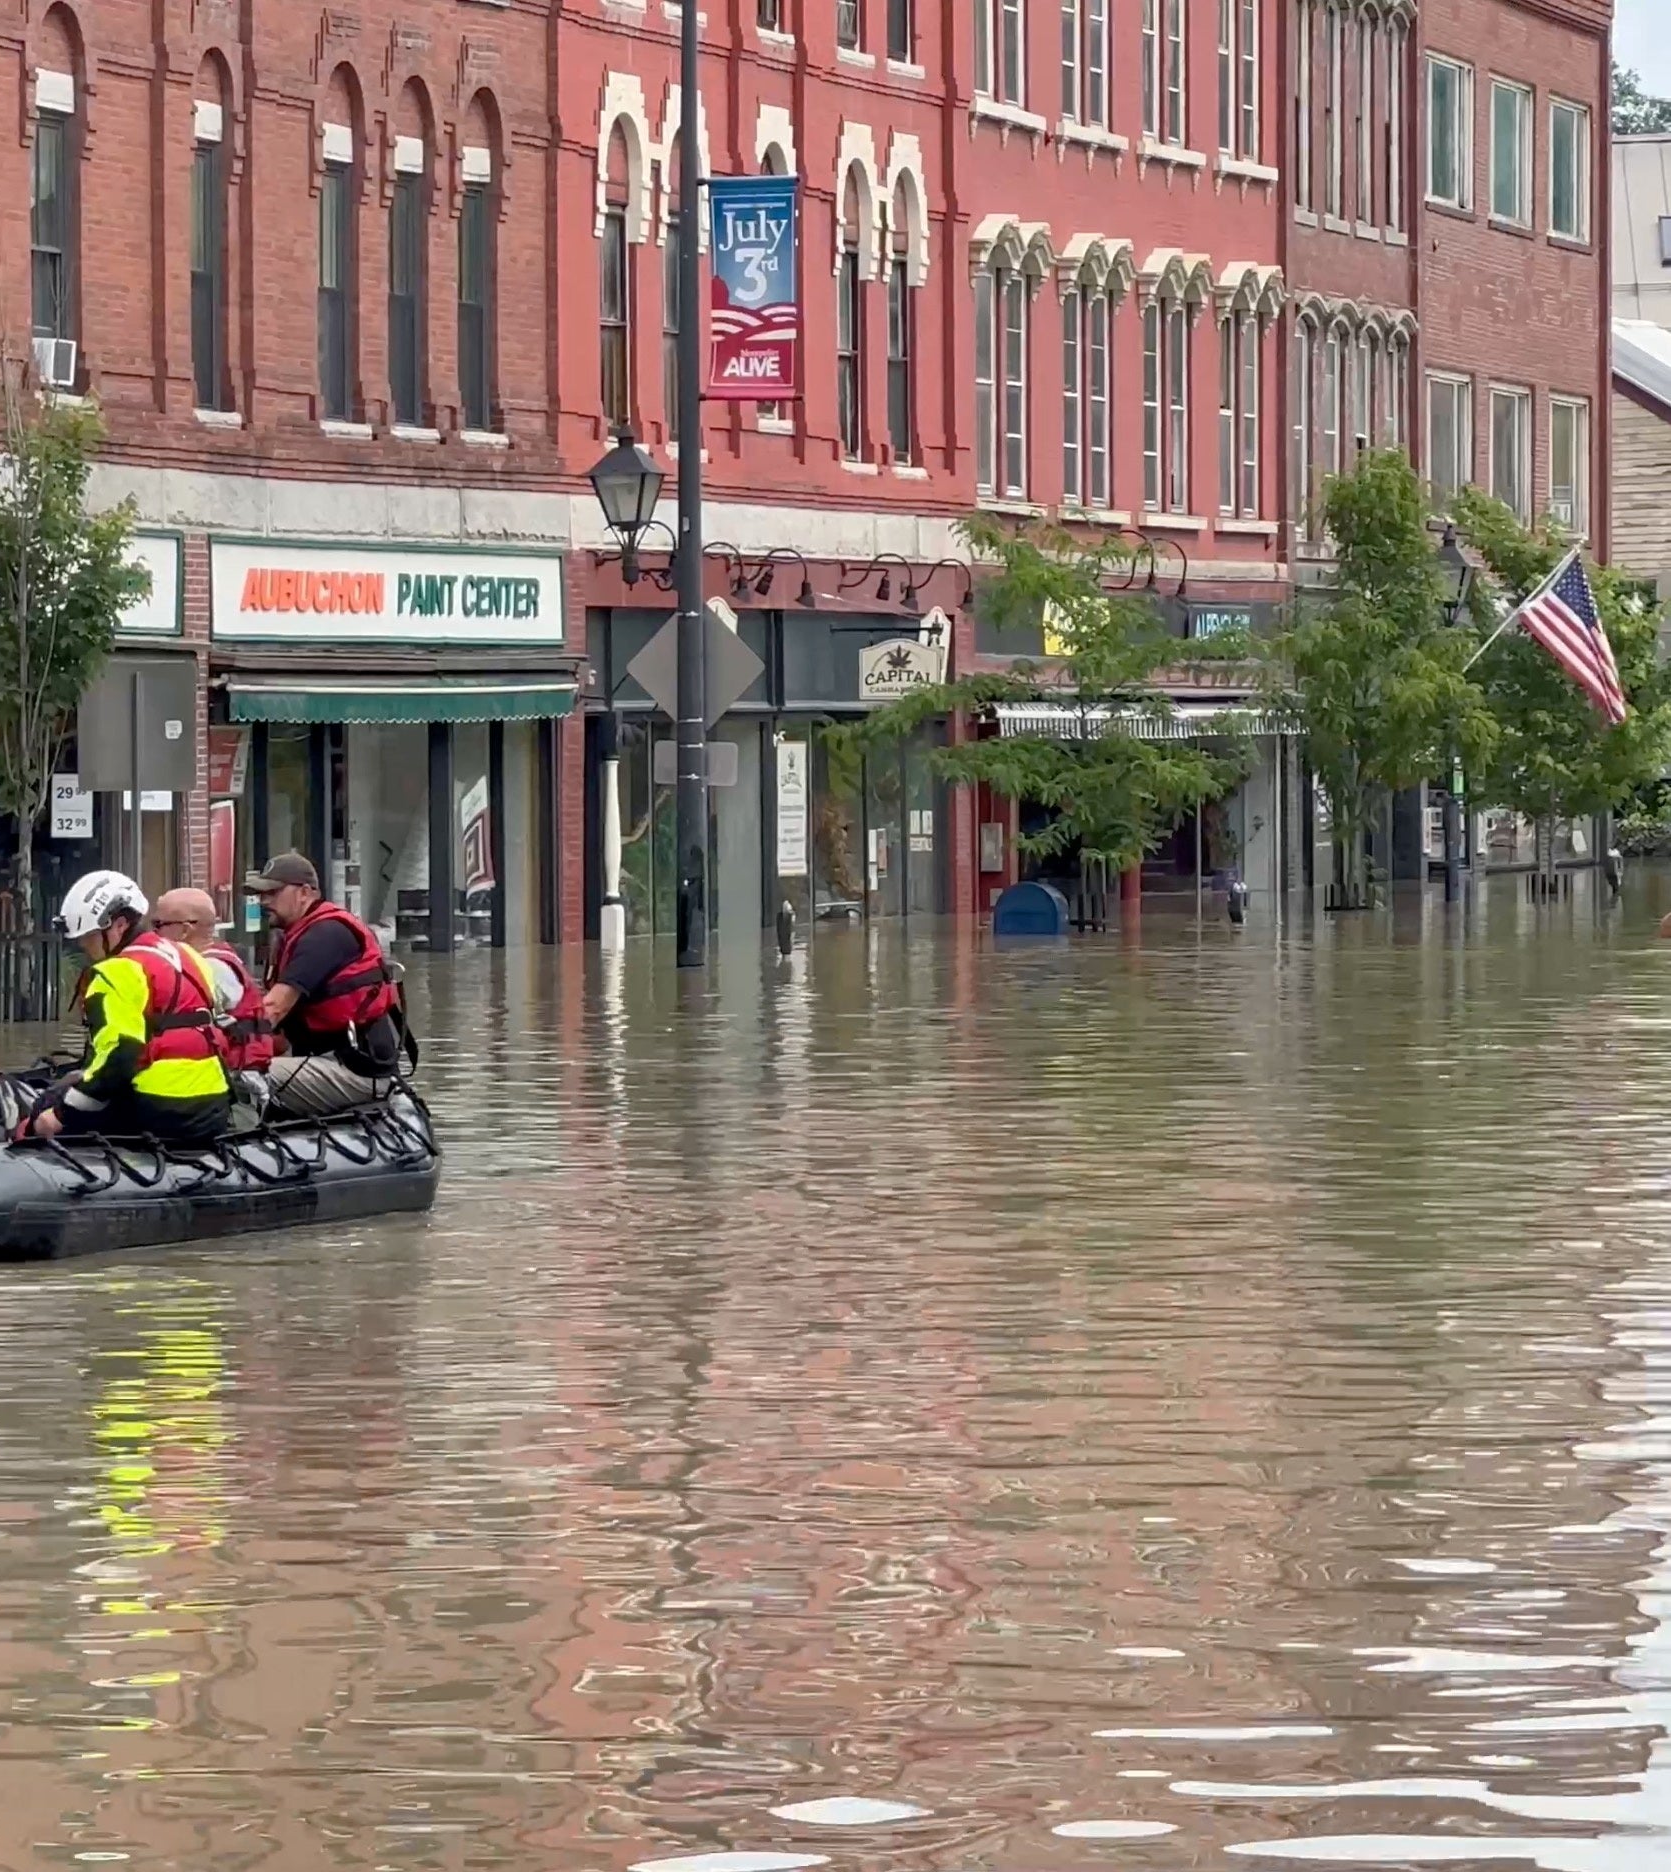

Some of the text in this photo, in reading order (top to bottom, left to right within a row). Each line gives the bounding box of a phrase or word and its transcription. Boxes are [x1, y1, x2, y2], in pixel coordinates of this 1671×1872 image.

[718, 209, 789, 254] July
[722, 356, 781, 378] ALIVE
[241, 568, 541, 619] AUBUCHON PAINT CENTER
[56, 786, 73, 799] 29
[56, 818, 73, 831] 32
